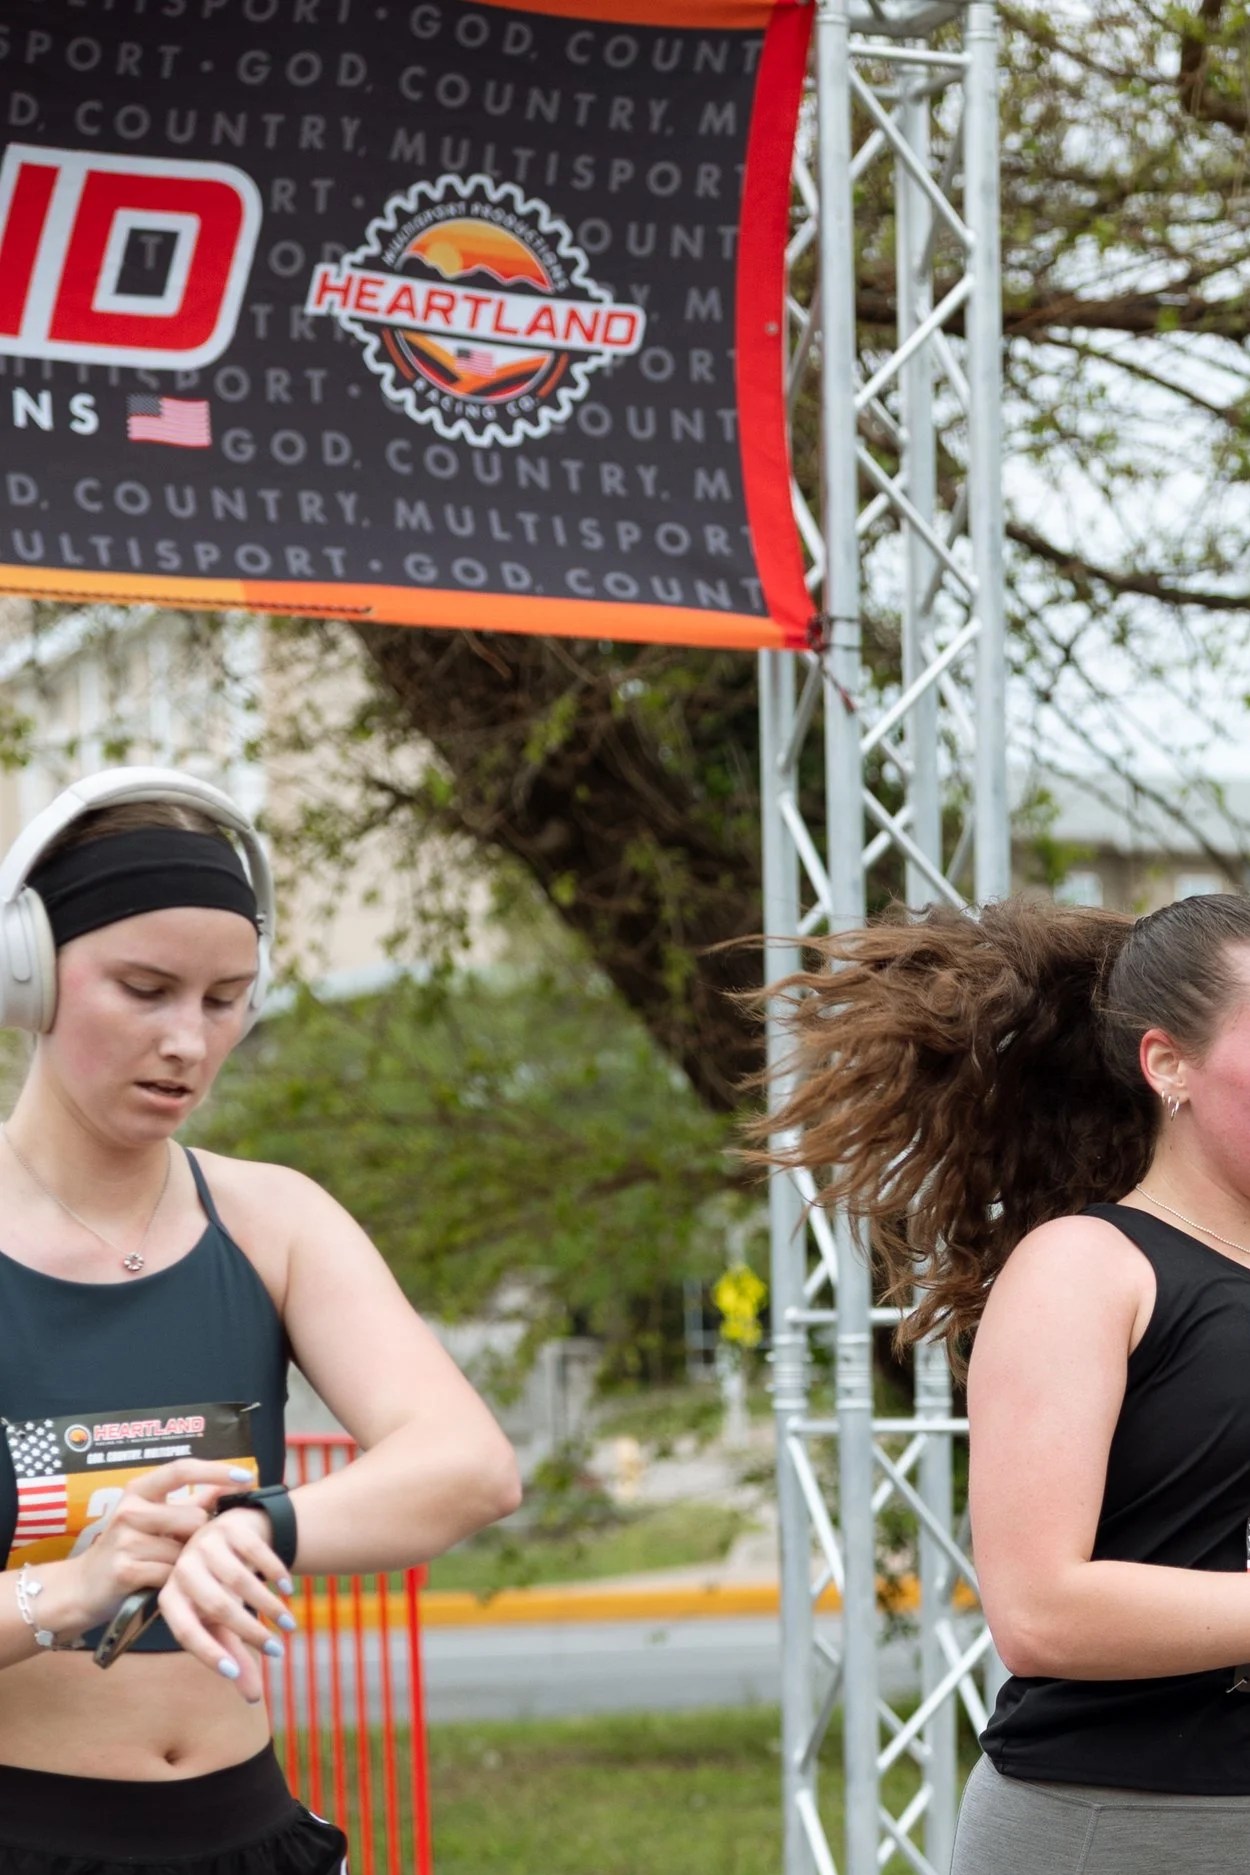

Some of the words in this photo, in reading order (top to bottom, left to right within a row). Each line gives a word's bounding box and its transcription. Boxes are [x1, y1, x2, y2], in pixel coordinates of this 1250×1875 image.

[237, 50, 373, 93] GOD,
[74, 100, 368, 157] COUNTRY,
[311, 270, 640, 348] HEARTLAND
[412, 377, 498, 421] RACING
[221, 427, 361, 470] GOD,
[72, 478, 370, 528] COUNTRY,
[93, 1416, 205, 1441] HEARTLAND
